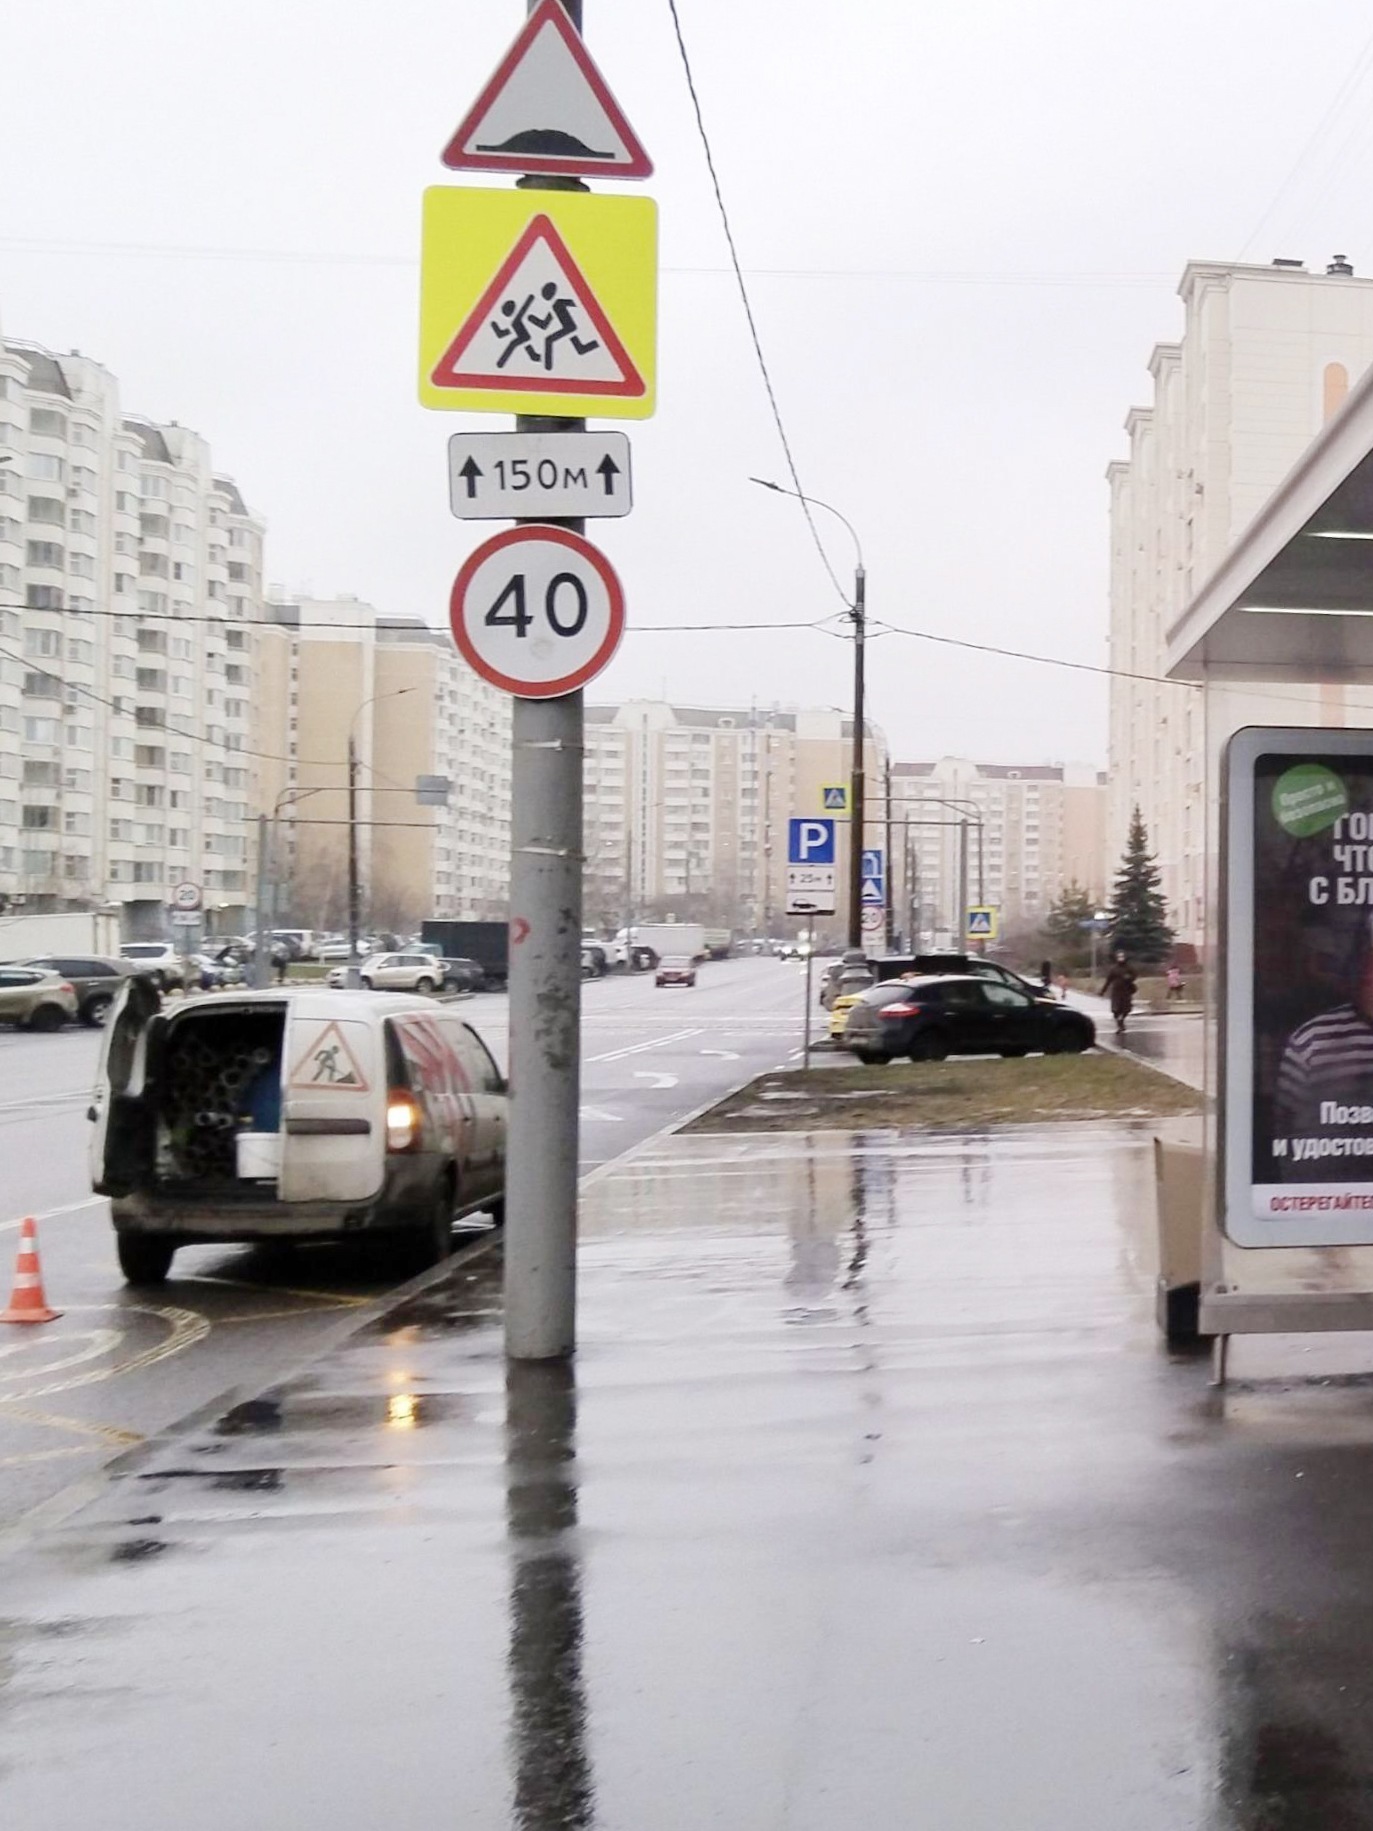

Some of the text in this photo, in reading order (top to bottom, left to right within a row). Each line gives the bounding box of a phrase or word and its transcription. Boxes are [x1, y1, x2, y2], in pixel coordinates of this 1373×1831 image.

[494, 459, 588, 491] 150м
[485, 572, 588, 638] 40
[799, 822, 829, 860] P
[1308, 876, 1329, 905] С
[1272, 1137, 1287, 1157] и
